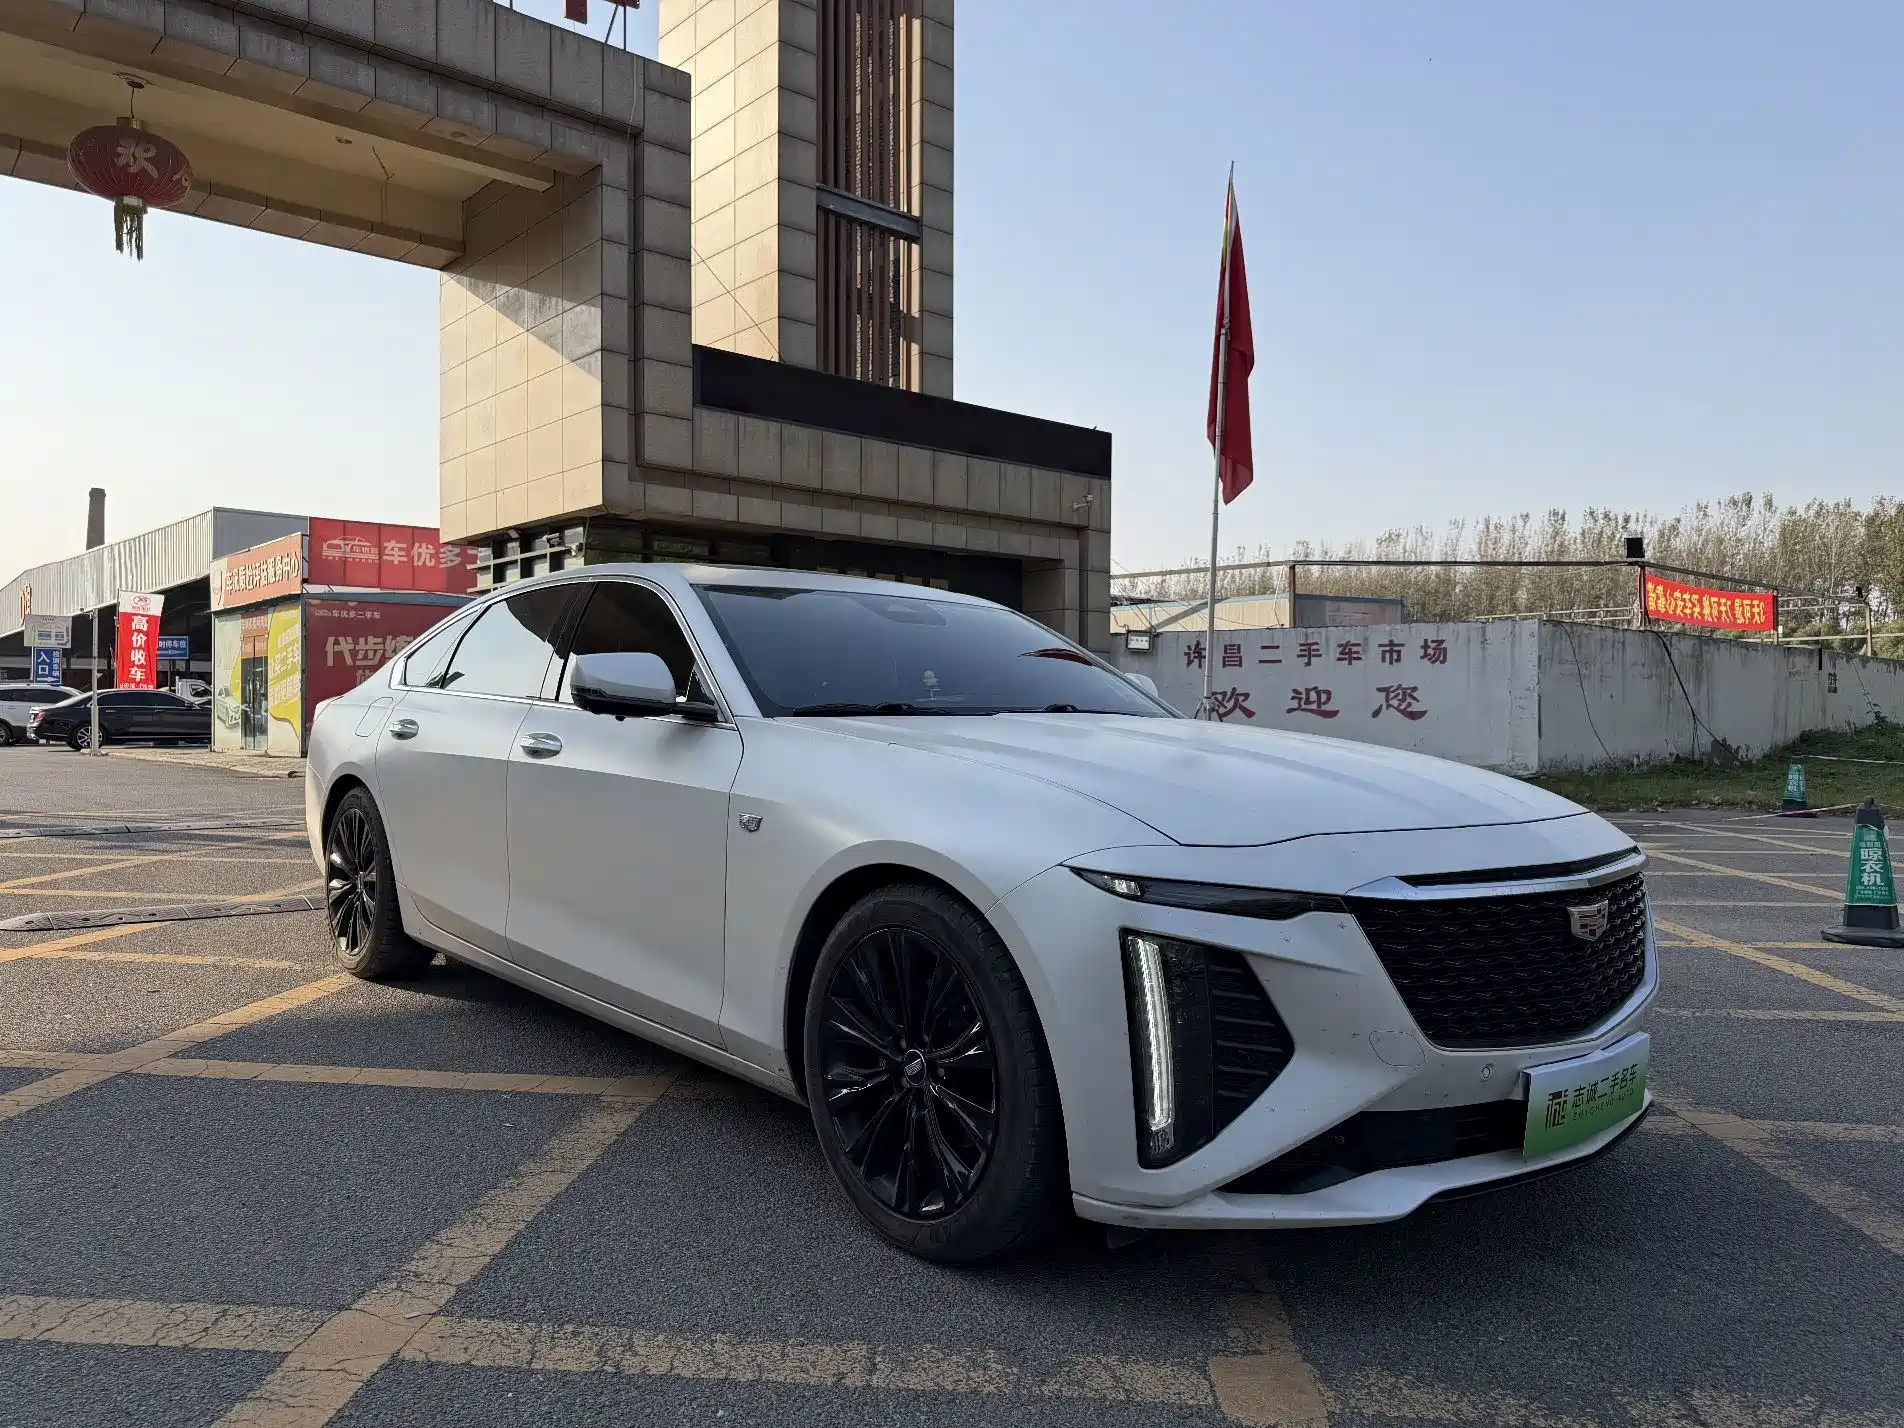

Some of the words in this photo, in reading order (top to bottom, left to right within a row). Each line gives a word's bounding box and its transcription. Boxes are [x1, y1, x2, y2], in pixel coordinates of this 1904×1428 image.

[129, 615, 148, 681] 高价收车
[157, 639, 187, 649] 时停车位
[1184, 639, 1448, 669] 许昌二手车市场
[37, 651, 50, 675] 入口
[1210, 684, 1428, 720] 欢迎您
[1860, 848, 1884, 885] 晾衣机
